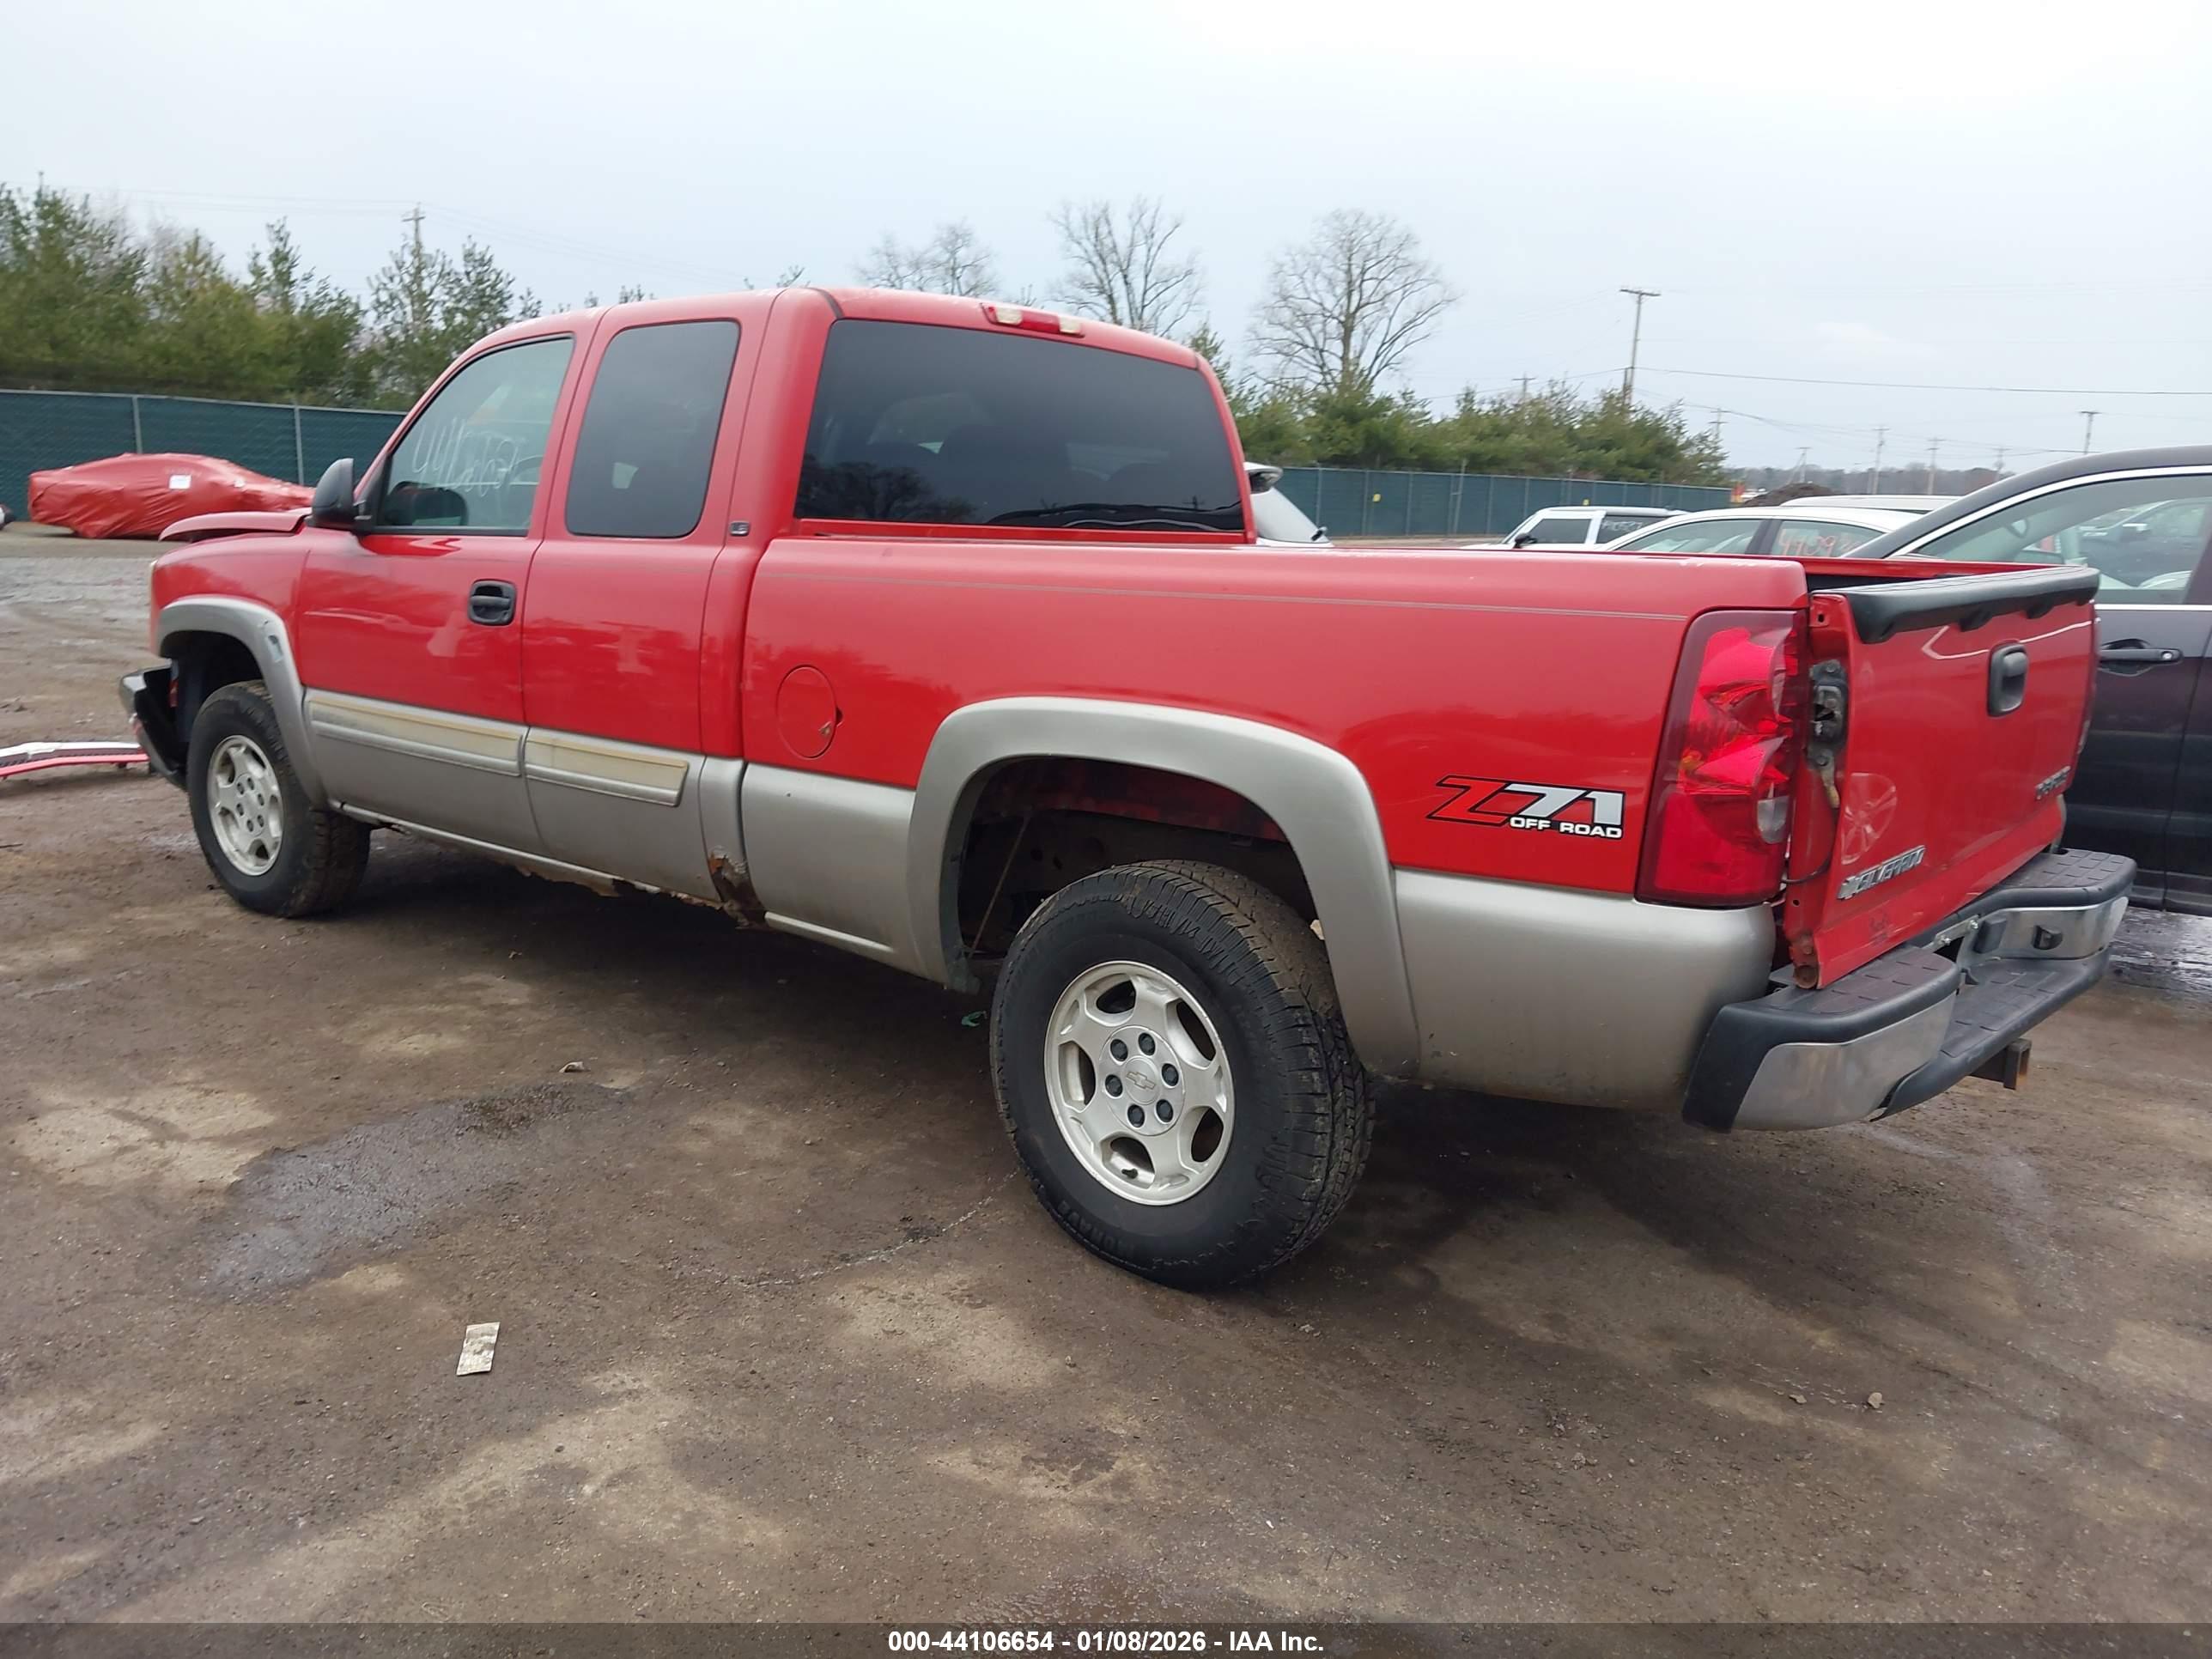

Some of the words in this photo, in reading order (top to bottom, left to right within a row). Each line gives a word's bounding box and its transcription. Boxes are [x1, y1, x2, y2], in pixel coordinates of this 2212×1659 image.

[1426, 775, 1627, 826] Z71
[1509, 816, 1551, 831] OFF
[1559, 821, 1624, 840] ROAD
